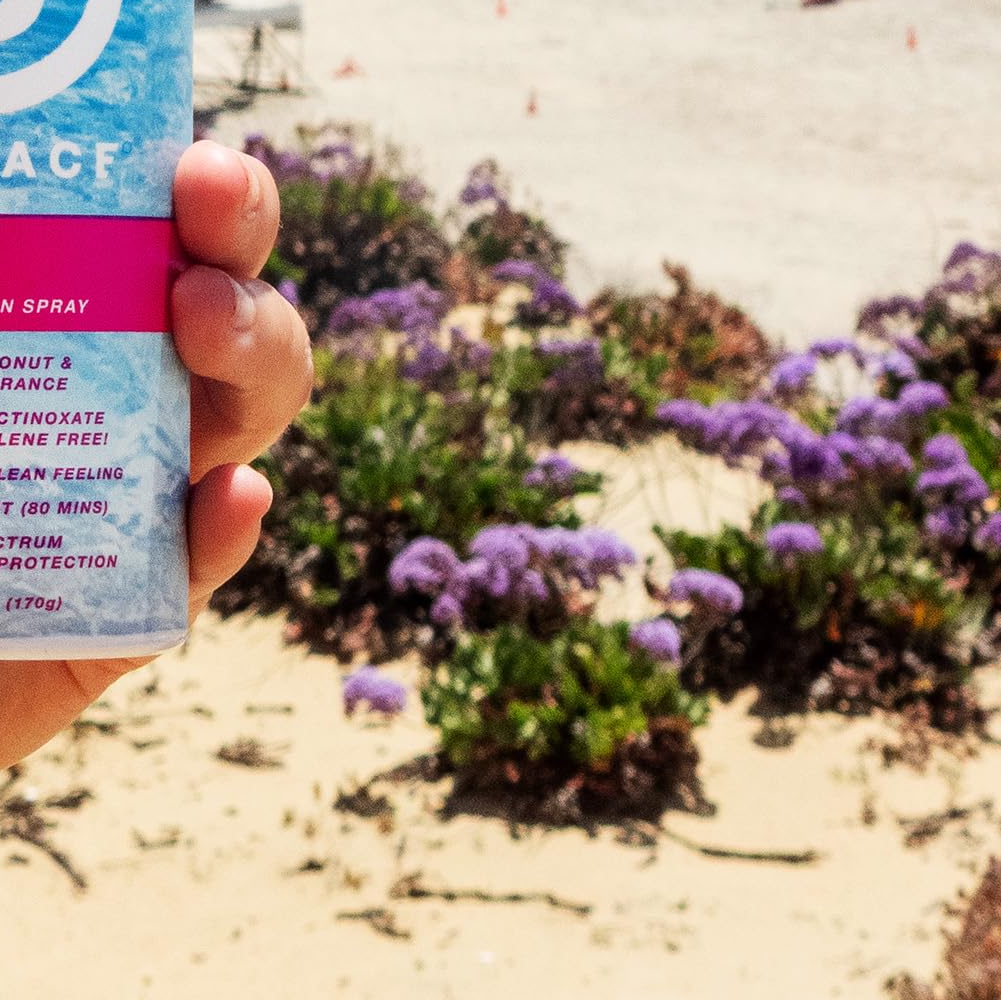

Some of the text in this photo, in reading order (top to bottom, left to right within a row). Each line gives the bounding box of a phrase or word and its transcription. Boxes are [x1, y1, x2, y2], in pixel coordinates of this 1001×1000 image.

[22, 299, 89, 314] SPRAY
[60, 356, 73, 370] &
[56, 432, 109, 446] FREE!
[52, 467, 124, 481] FEELING
[20, 501, 51, 518] (80
[56, 501, 109, 517] MINS)
[5, 597, 63, 613] (170g)
